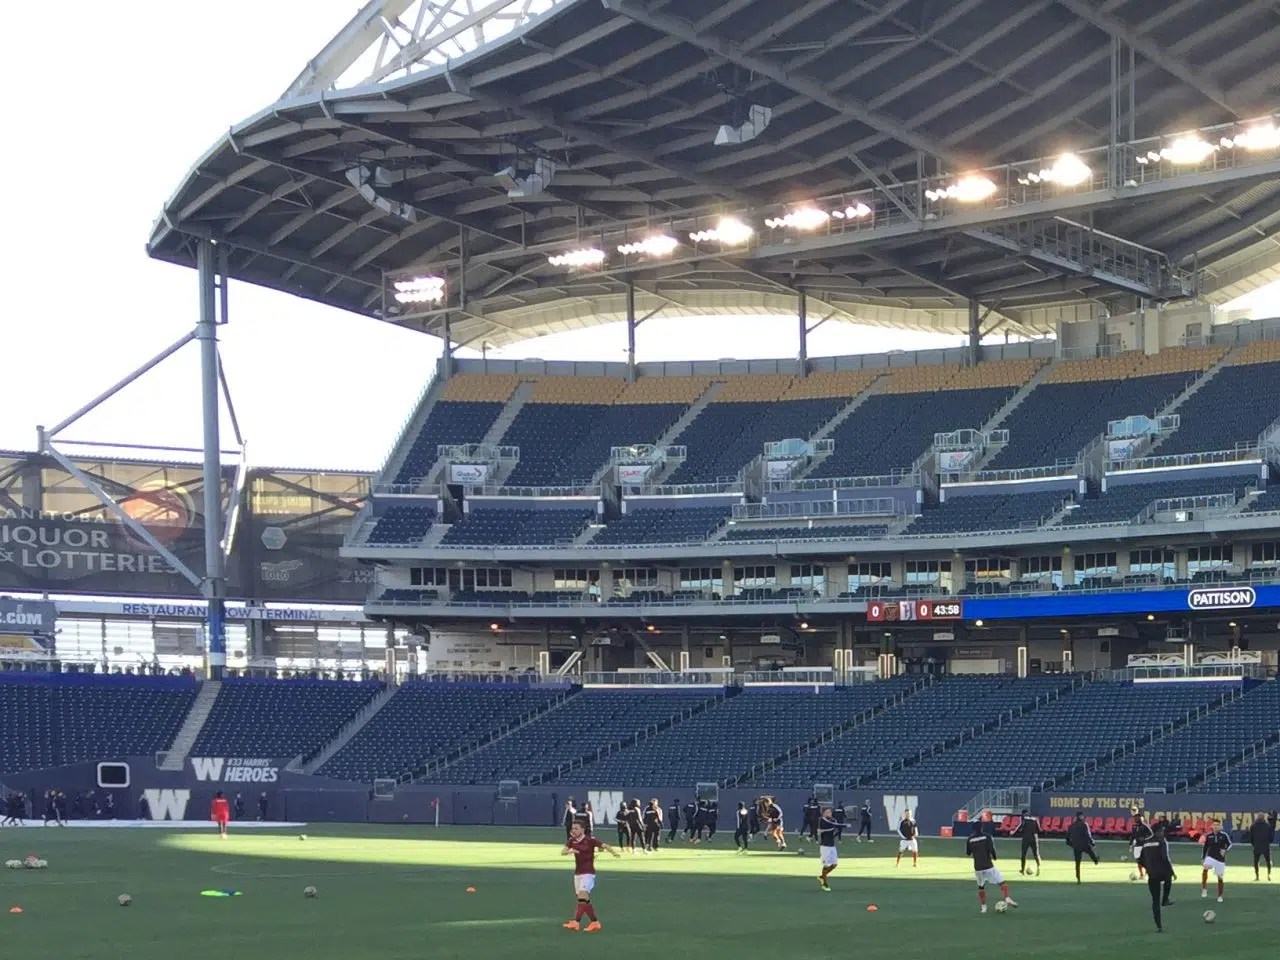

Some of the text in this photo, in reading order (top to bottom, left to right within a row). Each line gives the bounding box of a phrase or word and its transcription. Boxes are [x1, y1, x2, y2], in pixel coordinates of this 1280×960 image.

[0, 507, 106, 524] ANITOBA
[0, 524, 109, 548] IQUOR
[1193, 591, 1251, 605] PATTISON
[123, 604, 208, 617] RESTAURAN
[258, 609, 325, 620] TERMINAL
[872, 606, 880, 617] 0
[920, 605, 960, 616] 0 43:58
[224, 767, 278, 782] HEROES
[144, 789, 190, 820] W
[588, 791, 623, 824] W
[1050, 798, 1079, 808] HOME
[1082, 798, 1094, 808] OF
[1097, 798, 1116, 808] THE
